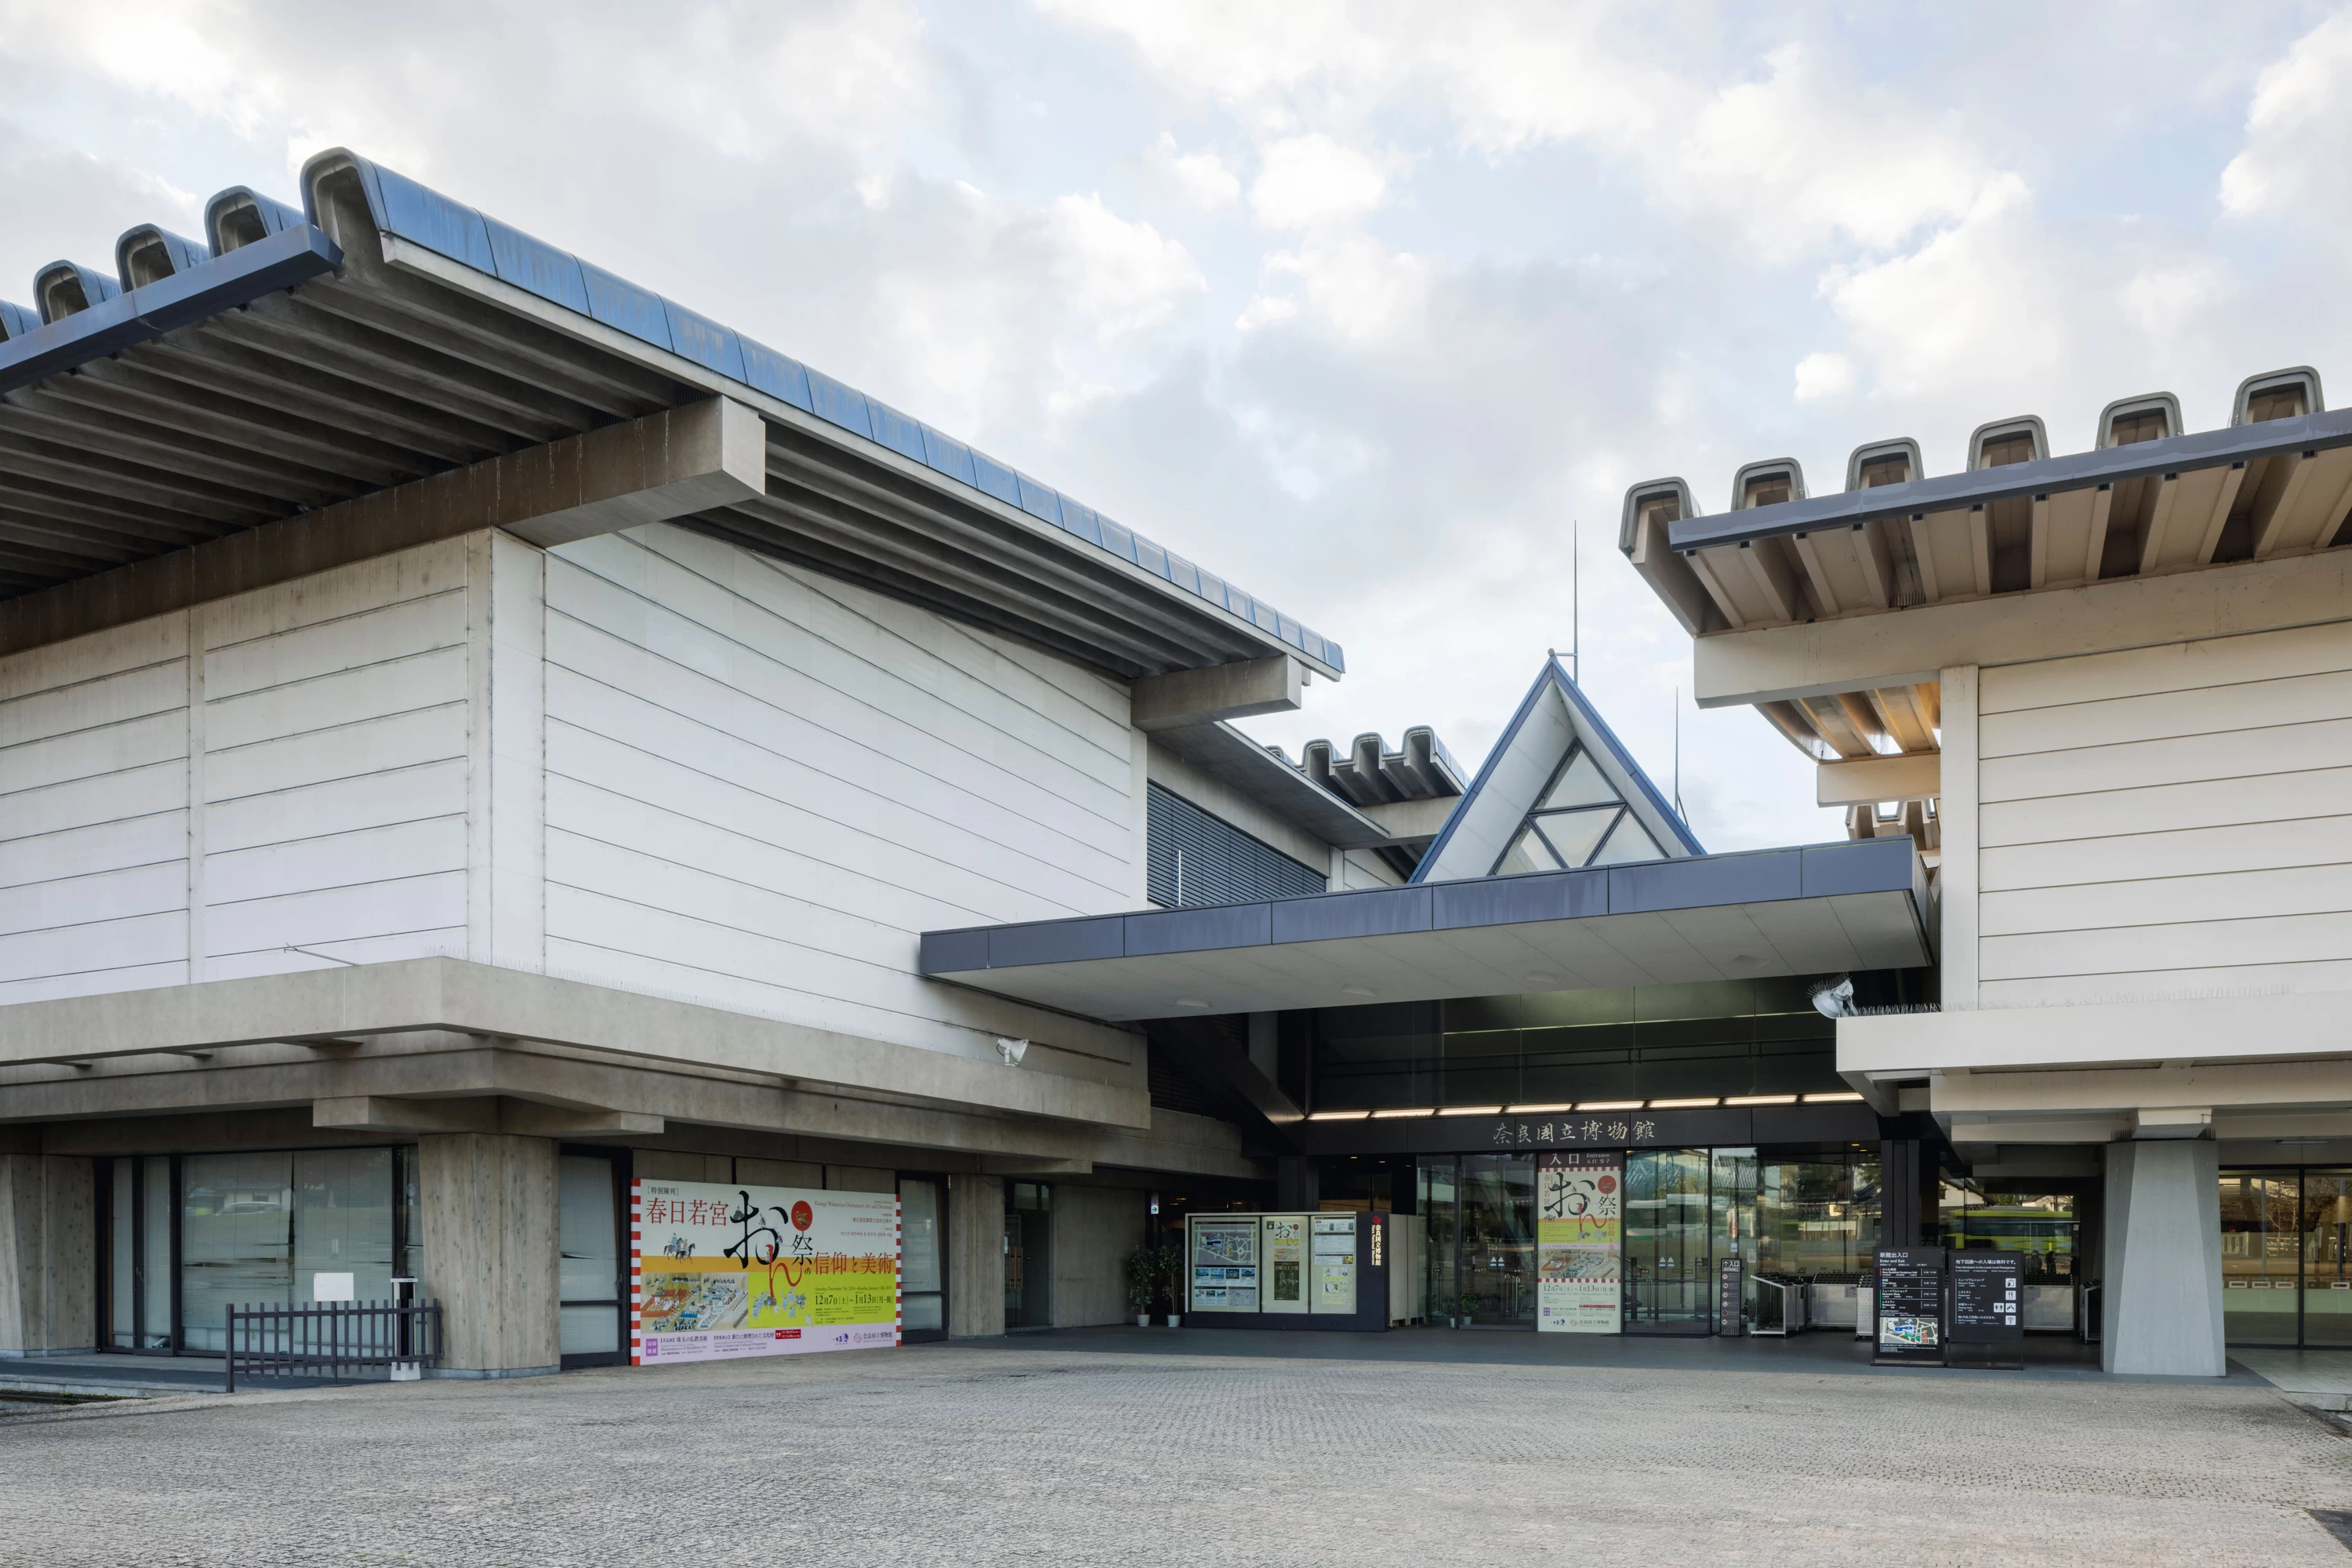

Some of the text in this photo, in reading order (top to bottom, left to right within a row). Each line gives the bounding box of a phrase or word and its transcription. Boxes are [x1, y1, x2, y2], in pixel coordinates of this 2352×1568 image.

[1494, 1120, 1655, 1145] 奈良國立博物館
[1550, 1153, 1579, 1165] 入口
[645, 1197, 729, 1226] 春日若宮
